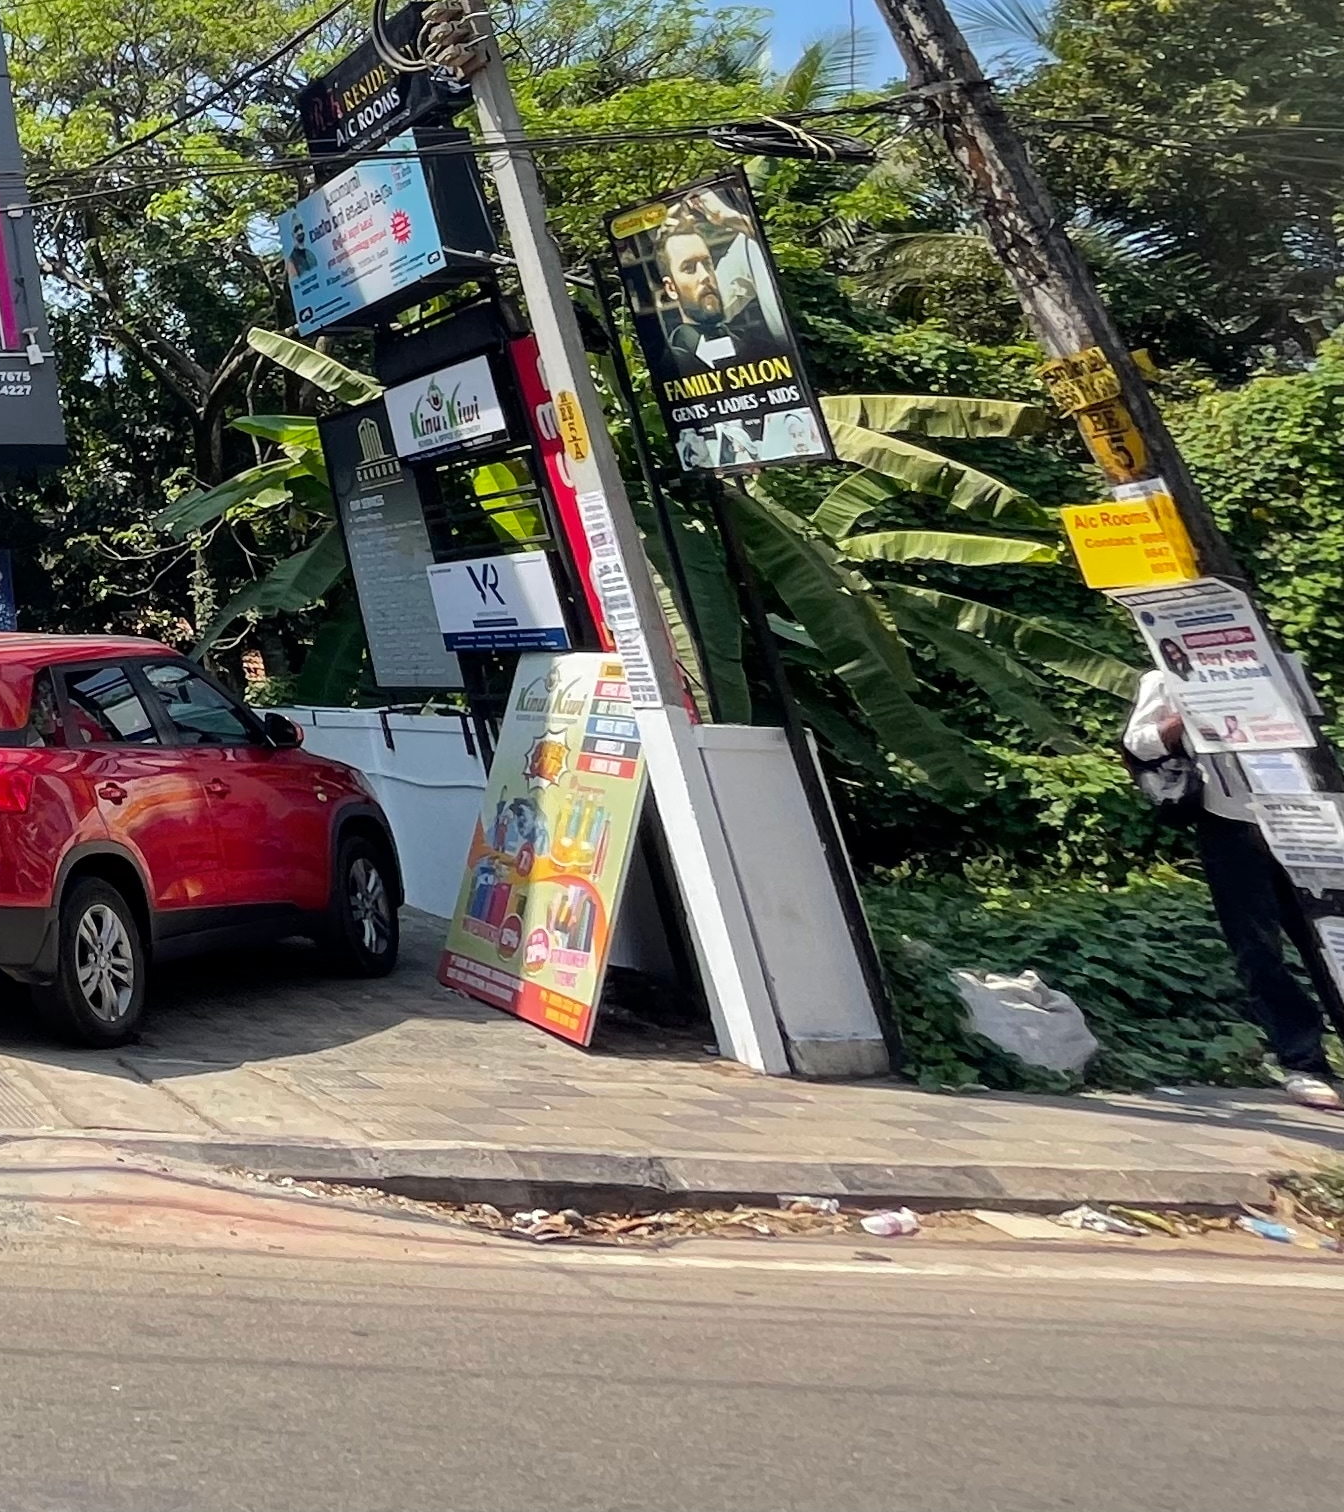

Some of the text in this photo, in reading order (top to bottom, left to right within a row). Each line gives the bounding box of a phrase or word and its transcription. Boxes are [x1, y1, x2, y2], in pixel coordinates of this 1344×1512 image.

[357, 87, 401, 131] ROOMS
[663, 356, 793, 402] FAMILY SALON
[446, 381, 481, 430] Kiwi
[672, 385, 800, 423] GENTS LADIES KIDS
